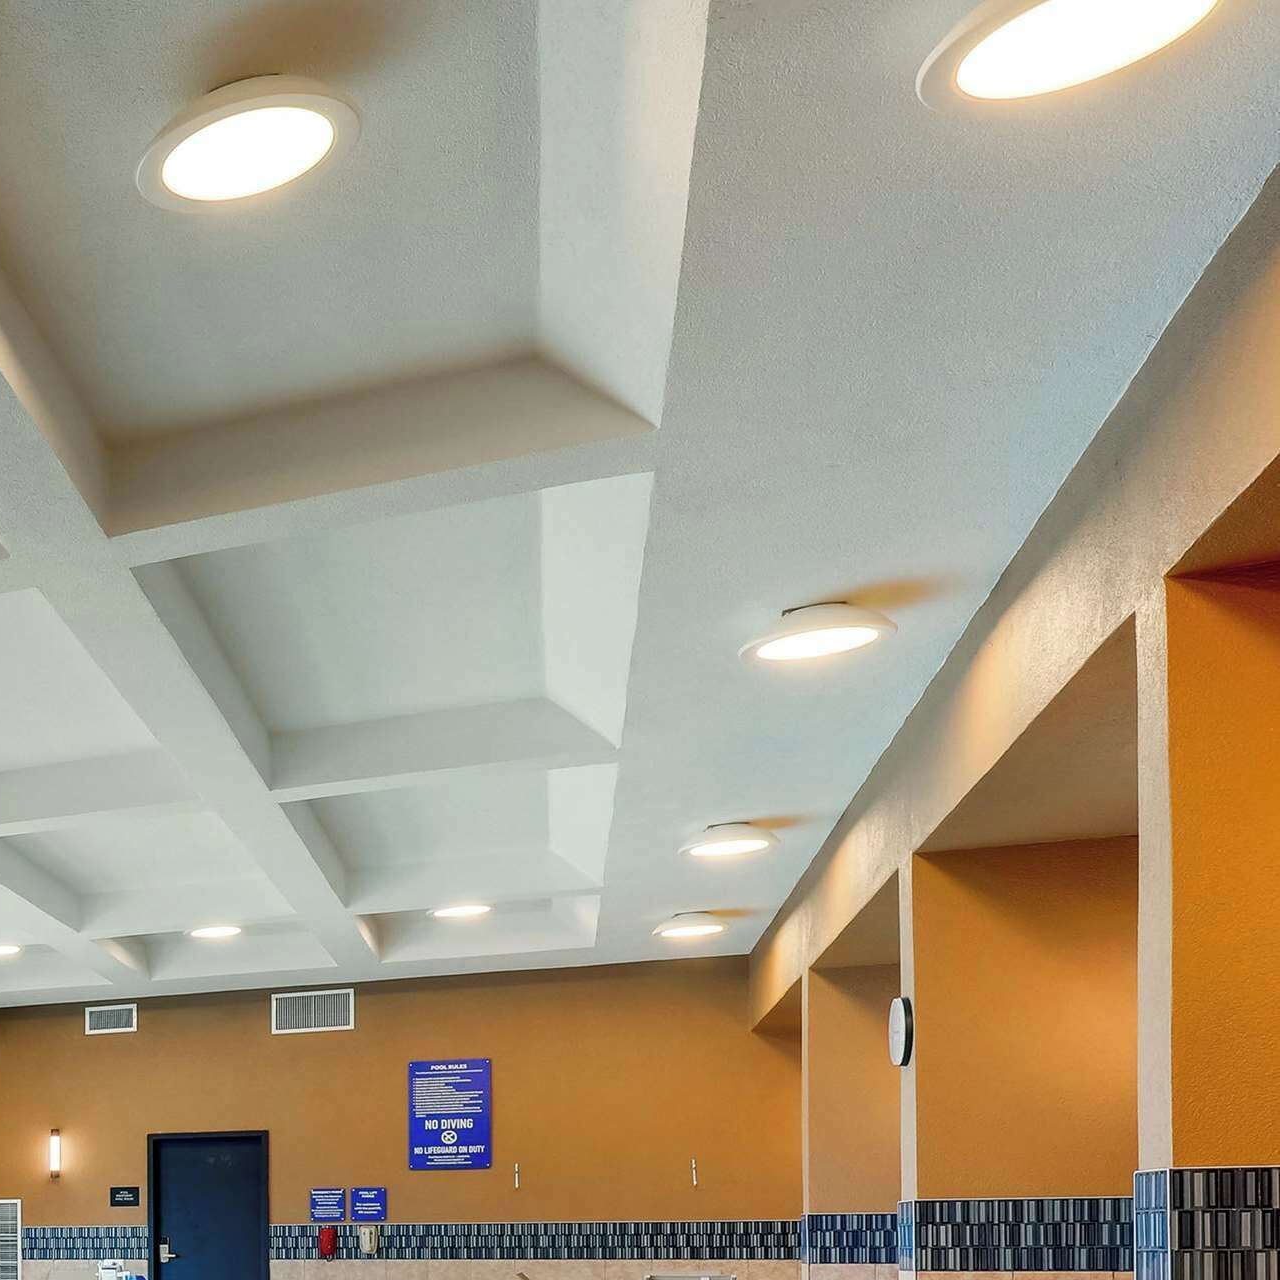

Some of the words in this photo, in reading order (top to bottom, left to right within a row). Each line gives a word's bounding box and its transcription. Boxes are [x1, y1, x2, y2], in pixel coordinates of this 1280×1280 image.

[425, 1119, 439, 1130] NO
[441, 1118, 474, 1129] DIVING
[414, 1147, 423, 1155] NO
[424, 1146, 458, 1154] LIFEGUARD
[469, 1145, 485, 1153] DUTY
